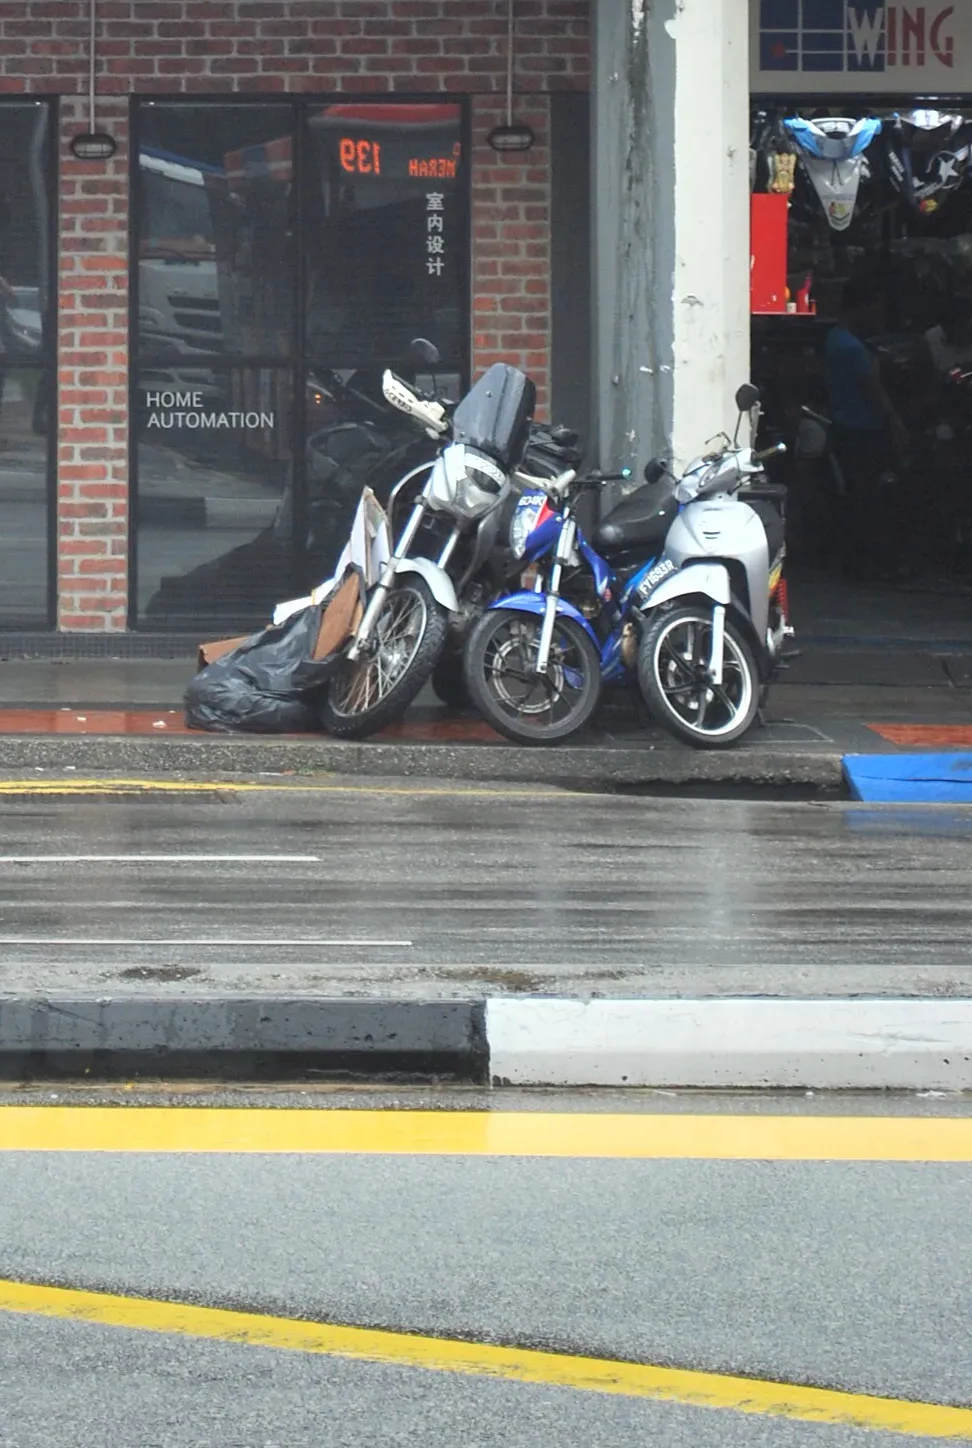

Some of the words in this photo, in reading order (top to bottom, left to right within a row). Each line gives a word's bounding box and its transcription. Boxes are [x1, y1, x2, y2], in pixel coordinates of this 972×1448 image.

[847, 6, 955, 68] WING
[426, 192, 445, 277] 室内设计
[146, 391, 204, 408] HOME
[147, 412, 275, 429] AUTOMATION
